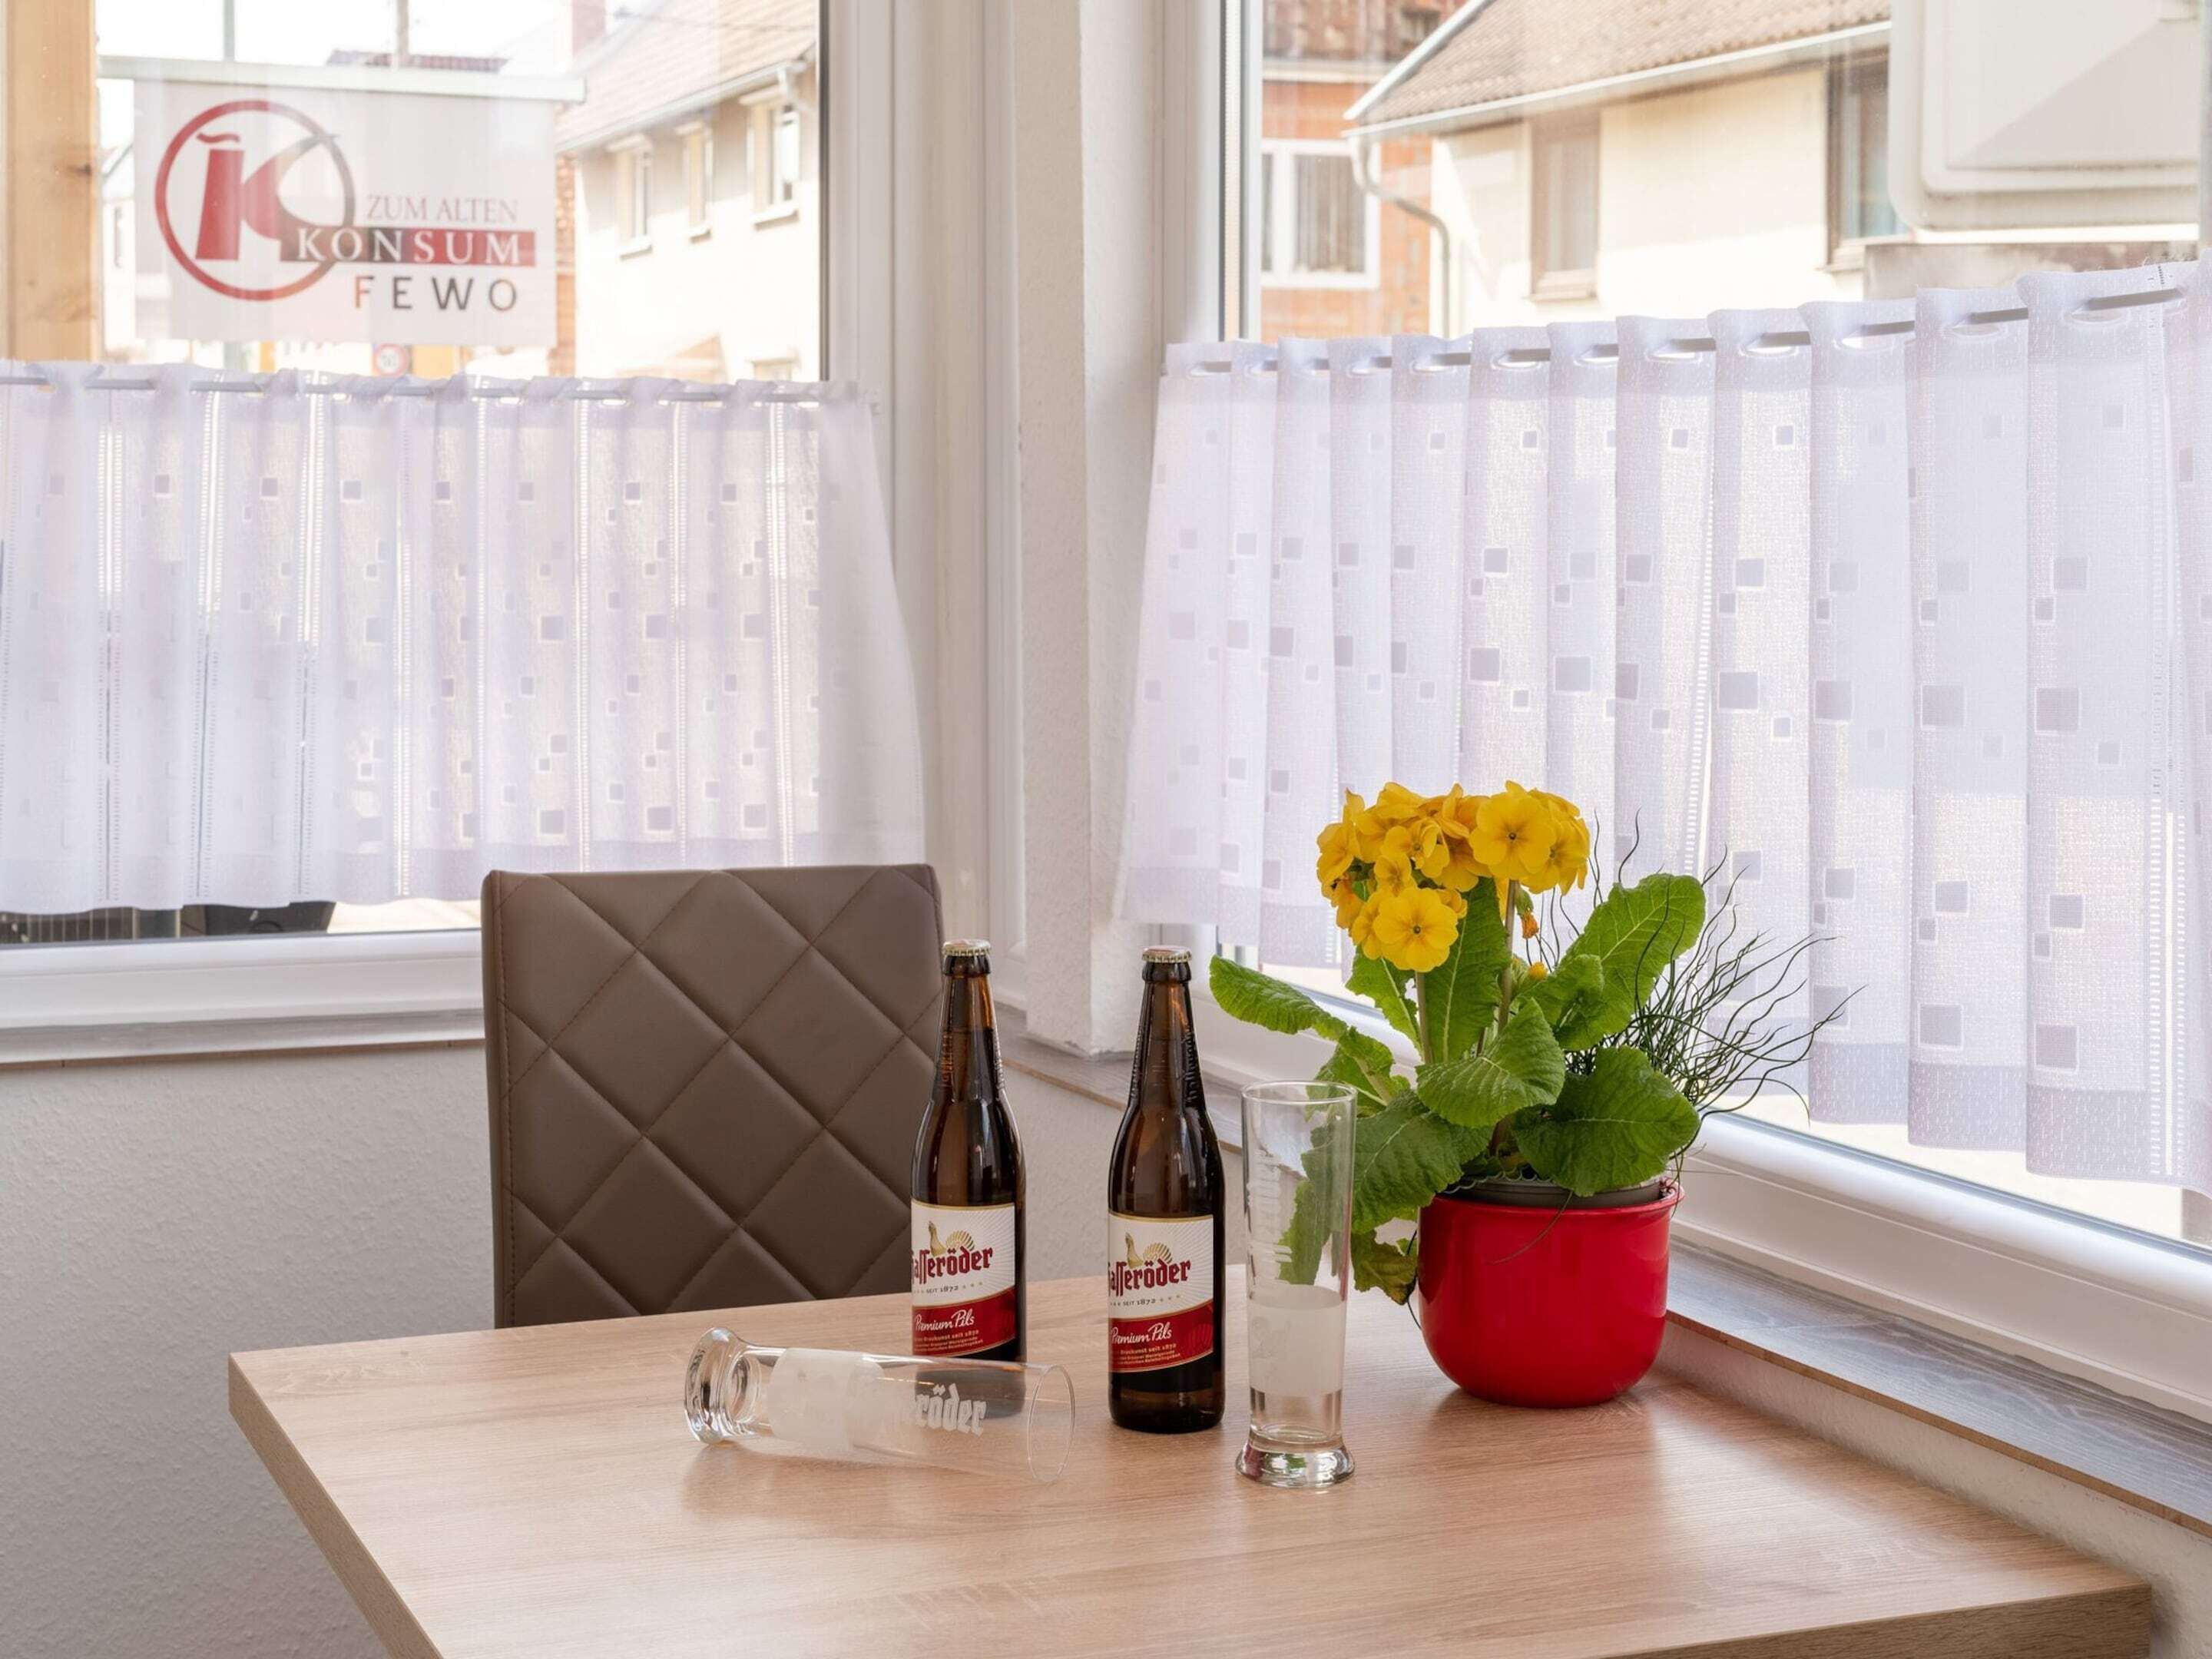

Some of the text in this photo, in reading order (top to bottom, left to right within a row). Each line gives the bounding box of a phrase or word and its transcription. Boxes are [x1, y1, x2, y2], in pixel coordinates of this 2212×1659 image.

[366, 195, 518, 223] ZUM ALTEN
[296, 228, 521, 265] KONSUM
[355, 275, 517, 311] FEWO
[951, 1308, 975, 1328] Pils
[1147, 1321, 1172, 1341] Pils
